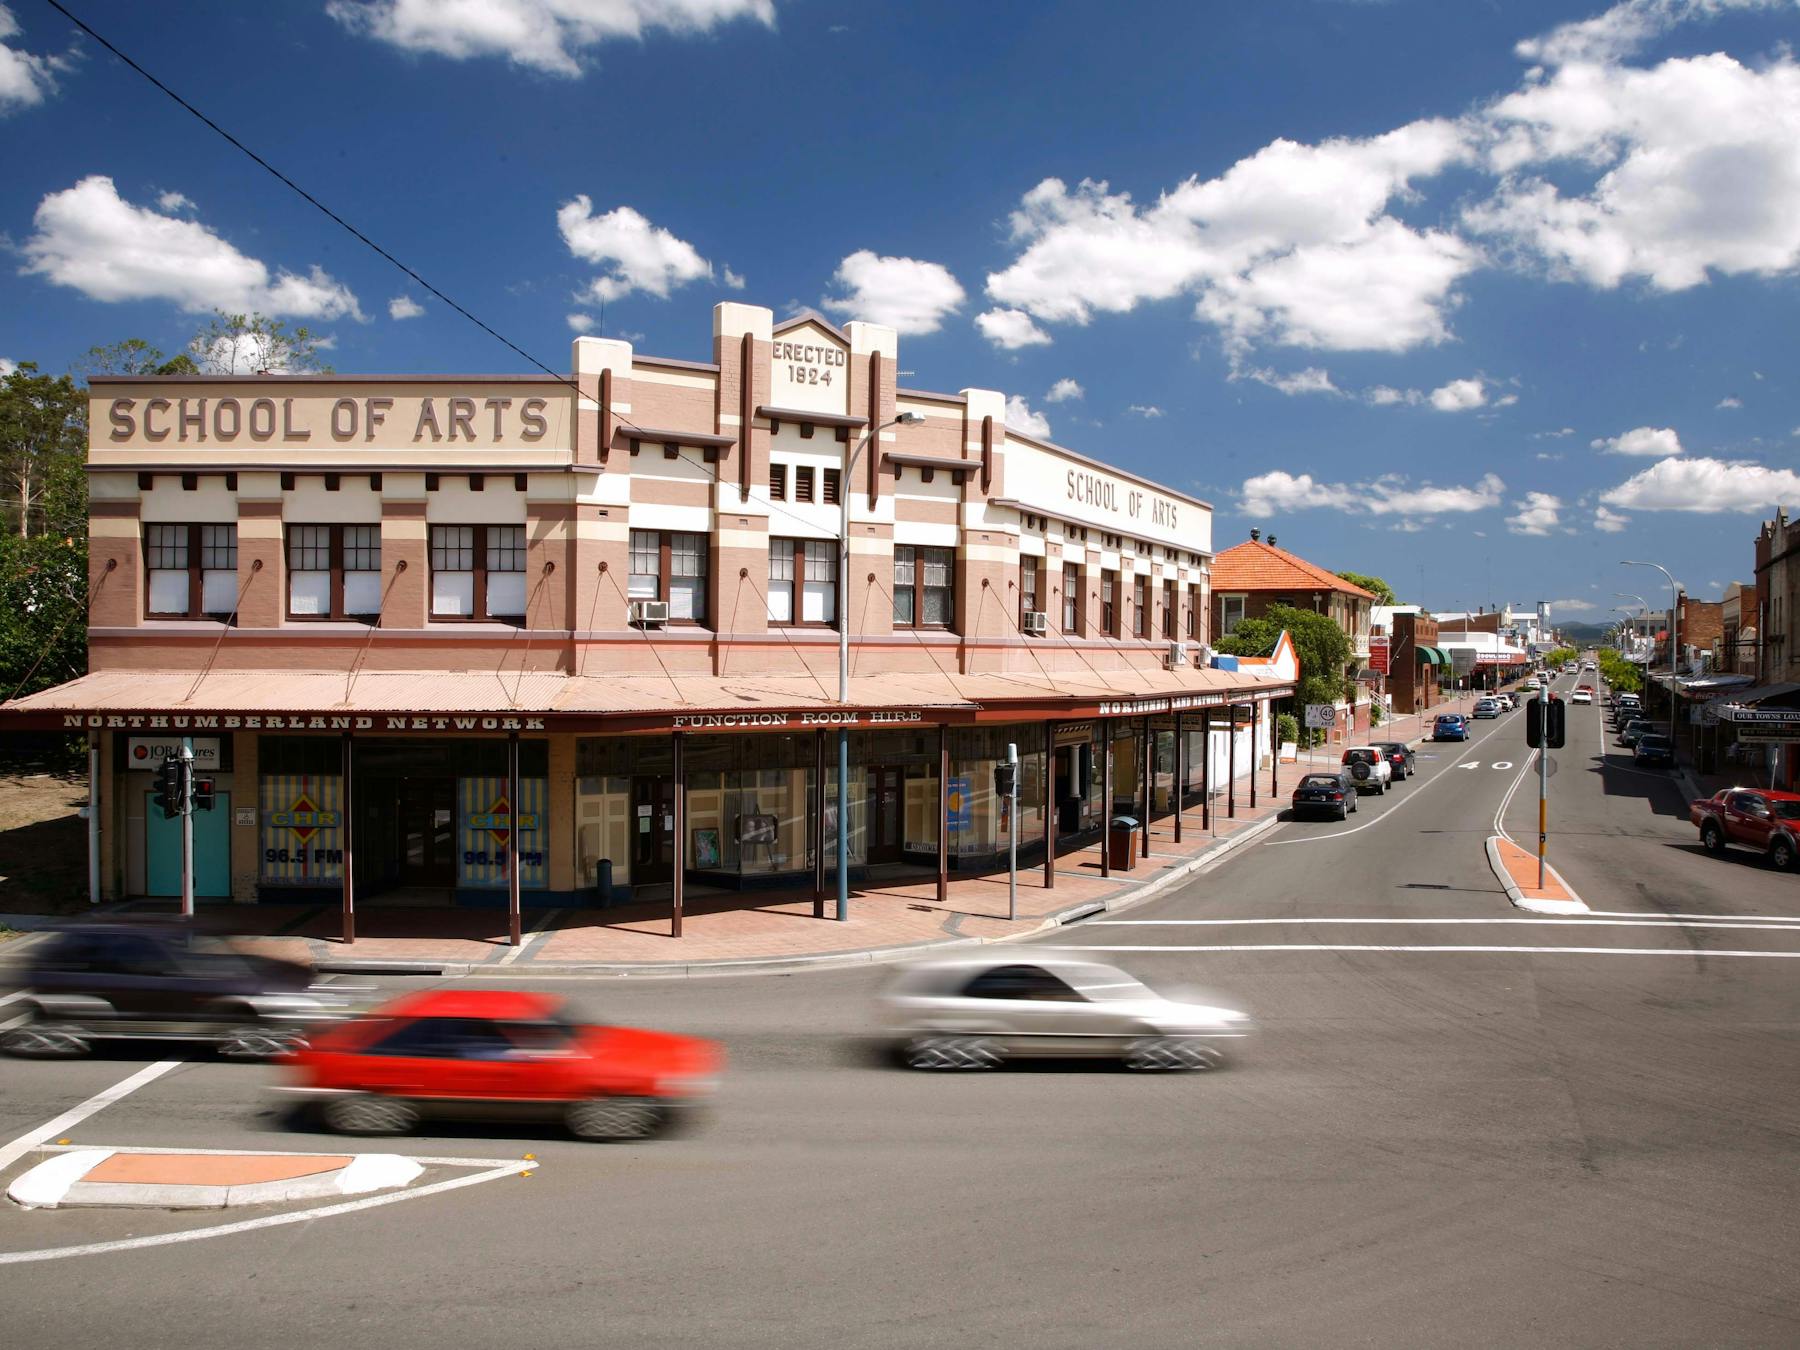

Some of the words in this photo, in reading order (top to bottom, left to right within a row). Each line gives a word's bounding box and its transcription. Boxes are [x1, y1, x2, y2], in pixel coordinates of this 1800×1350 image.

[772, 341, 845, 366] ERECTED
[109, 397, 312, 441] SCHOOL
[331, 397, 395, 440] OF
[414, 397, 549, 441] ARTS
[1067, 469, 1119, 512] SCHOOL
[1128, 490, 1144, 518] OF
[1151, 497, 1177, 529] ARTS
[673, 714, 789, 728] FUNCTION
[800, 712, 858, 724] ROOM
[870, 711, 922, 723] HIRE
[1322, 709, 1333, 718] 40
[64, 715, 374, 729] NORTHUMBERLAND
[386, 716, 546, 730] NETWORK
[1458, 761, 1513, 770] 40
[270, 811, 337, 826] CHR
[470, 815, 535, 828] CHR
[265, 848, 307, 864] 96.5
[314, 849, 342, 864] FM
[464, 851, 507, 865] 96.5
